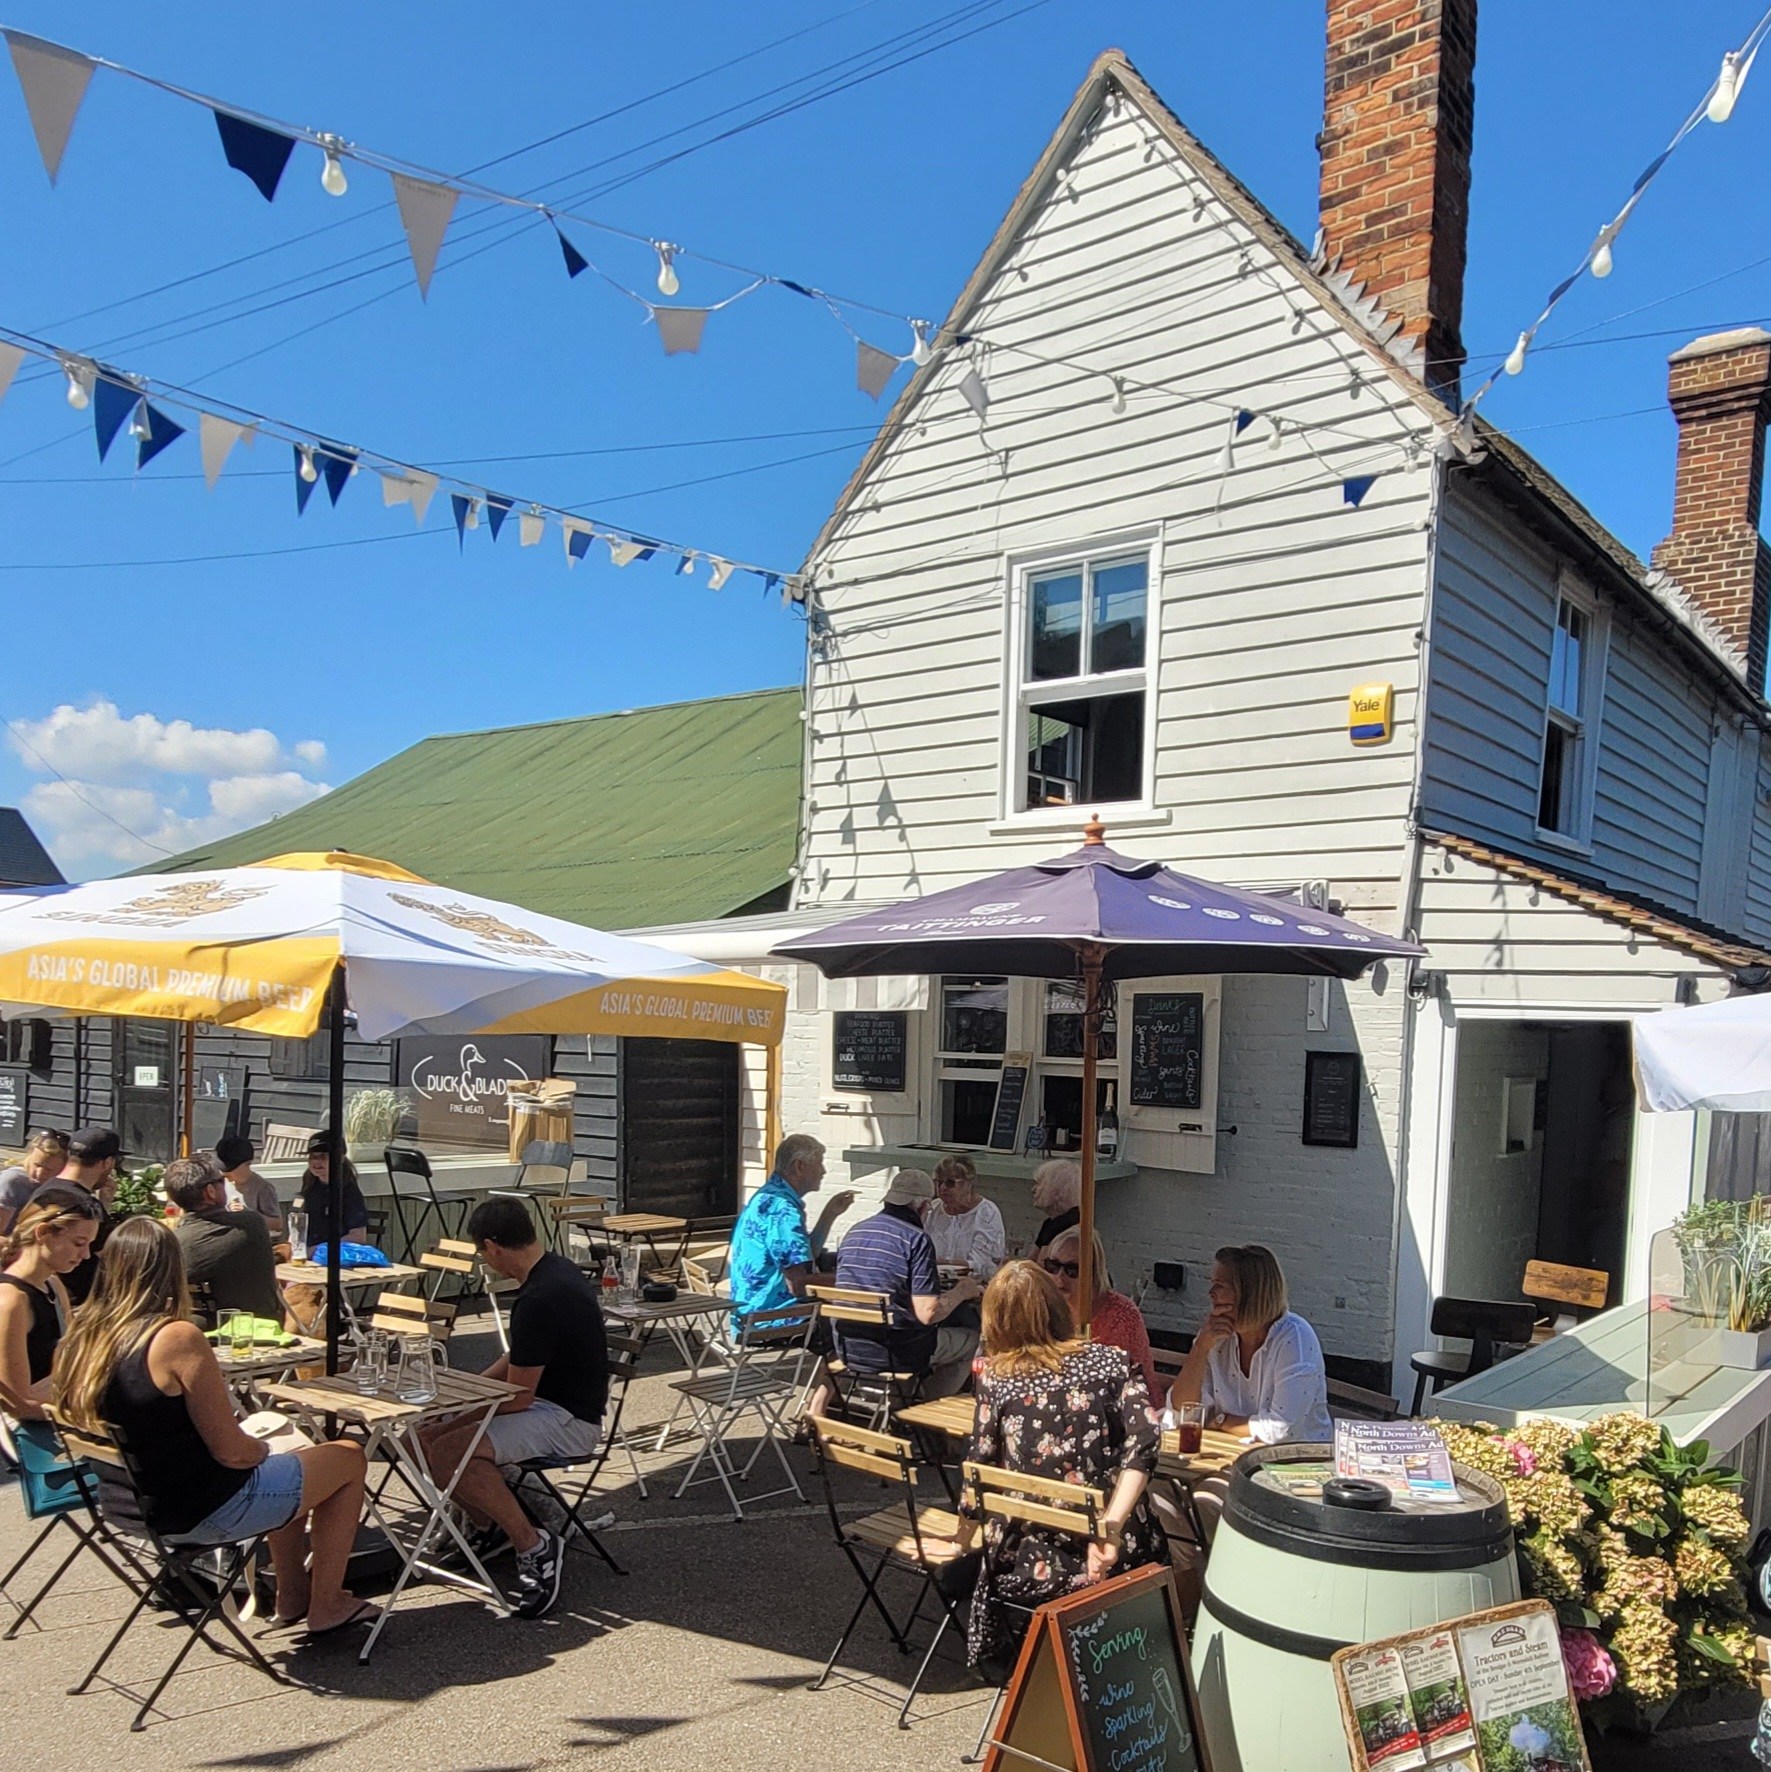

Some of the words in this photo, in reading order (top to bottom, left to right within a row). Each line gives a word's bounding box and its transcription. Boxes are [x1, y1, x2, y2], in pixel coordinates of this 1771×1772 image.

[1353, 699, 1380, 712] Yale
[877, 915, 1047, 932] TAITTINGER
[27, 953, 86, 983] ASIA'S
[89, 959, 161, 993] GLOBAL
[164, 968, 251, 1002] PREMIUM
[600, 992, 643, 1015] ASIA'S
[645, 995, 688, 1019] GLOBAL
[691, 1000, 745, 1026] PREMIUM
[840, 1053, 856, 1061] DUCK
[428, 1074, 459, 1093] DUCK
[475, 1077, 508, 1096] BLAD
[449, 1103, 463, 1114] FINE
[465, 1105, 485, 1115] MEATS
[1350, 1426, 1379, 1437] North
[1382, 1430, 1418, 1438] Downs
[1420, 1429, 1436, 1437] Ad
[1358, 1442, 1388, 1452] North
[1390, 1443, 1427, 1451] Downs
[1428, 1440, 1444, 1449] Ad
[1088, 1627, 1148, 1674] Serving
[1474, 1652, 1507, 1667] Tractors
[1509, 1647, 1523, 1657] and
[1525, 1641, 1548, 1653] Steam
[1470, 1679, 1486, 1689] OPEN
[1487, 1676, 1499, 1685] DAY
[1503, 1669, 1522, 1682] Sunday
[1534, 1660, 1560, 1673] September
